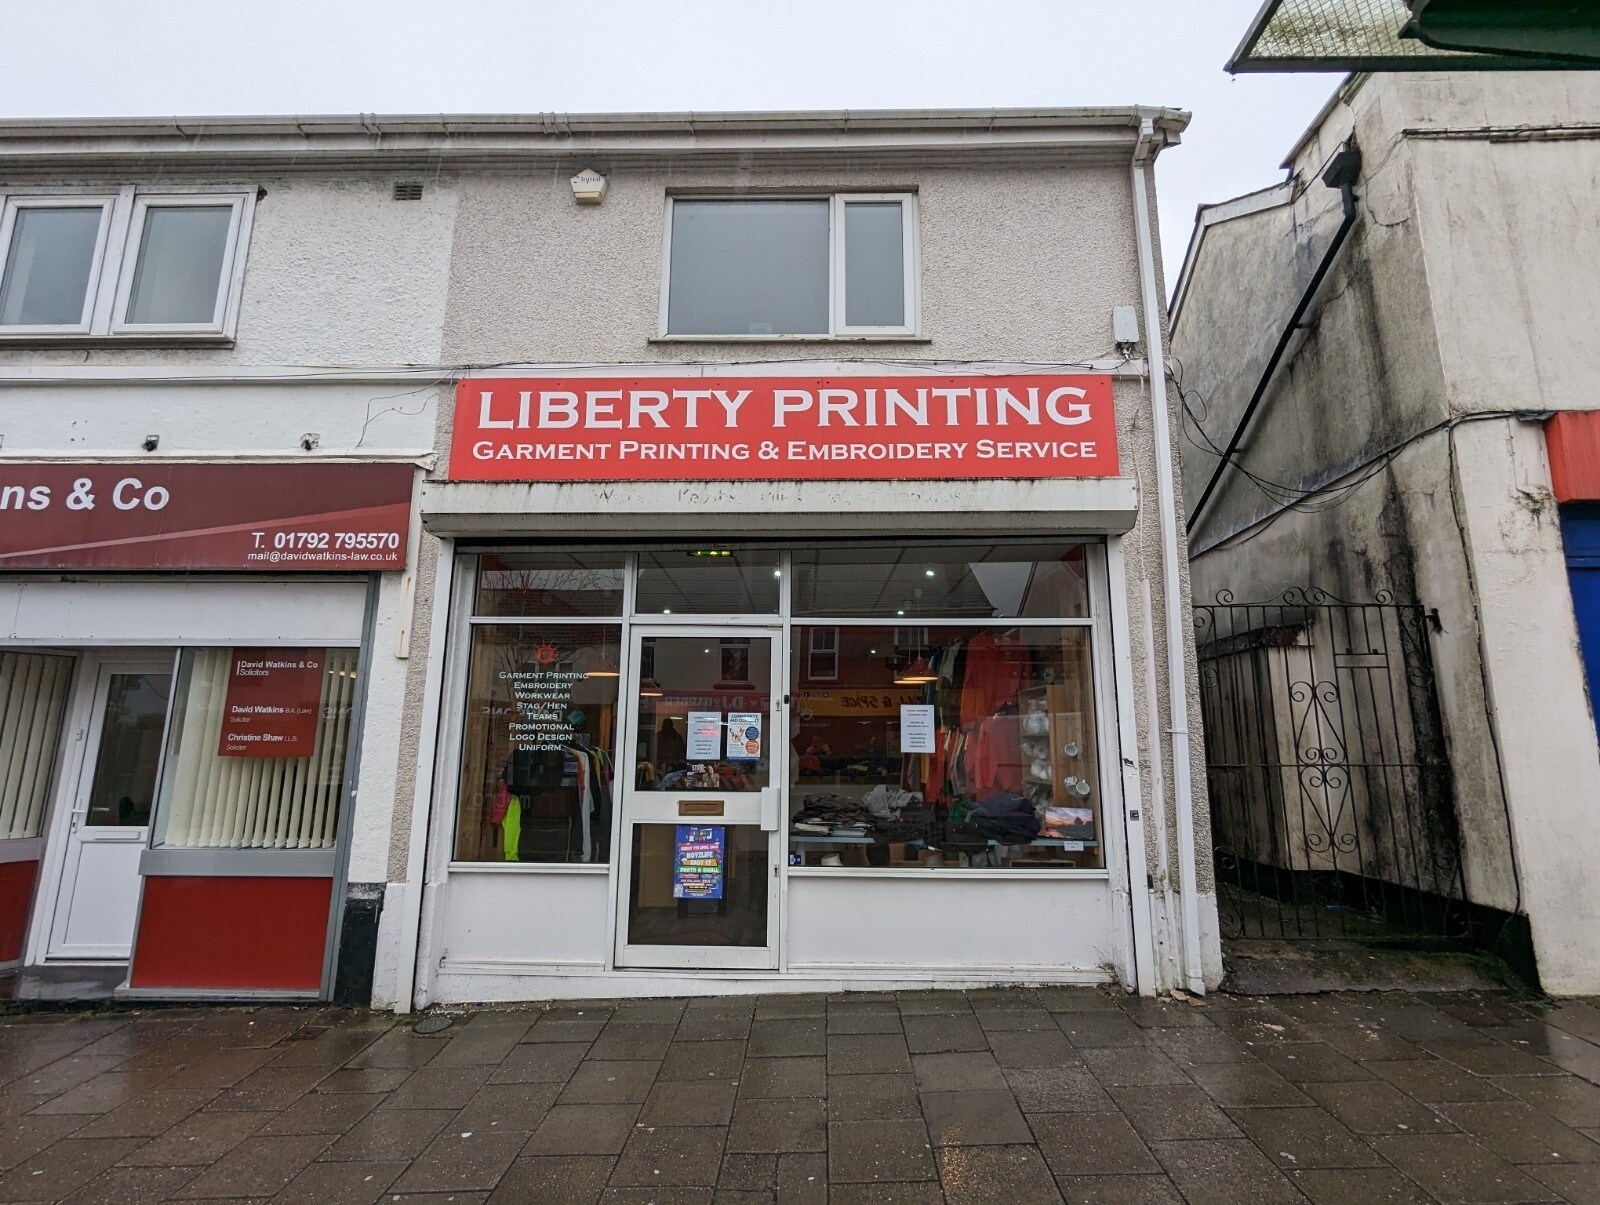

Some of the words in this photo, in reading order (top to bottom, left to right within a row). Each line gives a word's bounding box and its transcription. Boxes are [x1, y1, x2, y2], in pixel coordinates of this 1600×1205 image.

[478, 388, 753, 430] LIBERTY
[773, 387, 1093, 428] PRINTING
[472, 441, 612, 461] GARMENT
[619, 441, 750, 461] PRINTING
[757, 440, 779, 460] &
[787, 440, 968, 461] EMBROIDERY
[976, 440, 1097, 460] SERVICE
[66, 477, 96, 511] &
[112, 477, 170, 511] Co
[252, 533, 265, 549] T.
[274, 533, 329, 549] 01792
[334, 533, 400, 549] 795570
[247, 551, 398, 563] mail@davidwatkins-law.co.uk
[241, 660, 264, 668] David
[265, 660, 296, 668] Watkins
[307, 661, 318, 669] Co
[239, 668, 269, 676] Solicitors
[499, 671, 545, 679] GARMENT
[546, 671, 589, 679] PRINTING
[514, 681, 573, 689] EMBROIDERY
[515, 691, 570, 700] WORKWEAR
[231, 705, 253, 713] David
[254, 705, 284, 713] Watkins
[516, 701, 568, 711] STAG/HEN
[526, 712, 558, 720] TEAMS
[509, 722, 574, 730] PROMOTIONAL
[228, 733, 261, 741] Christine
[262, 733, 284, 741] Shaw
[509, 733, 535, 741] LOGO
[537, 733, 573, 741] DESIGN
[519, 743, 562, 751] UNIFORM
